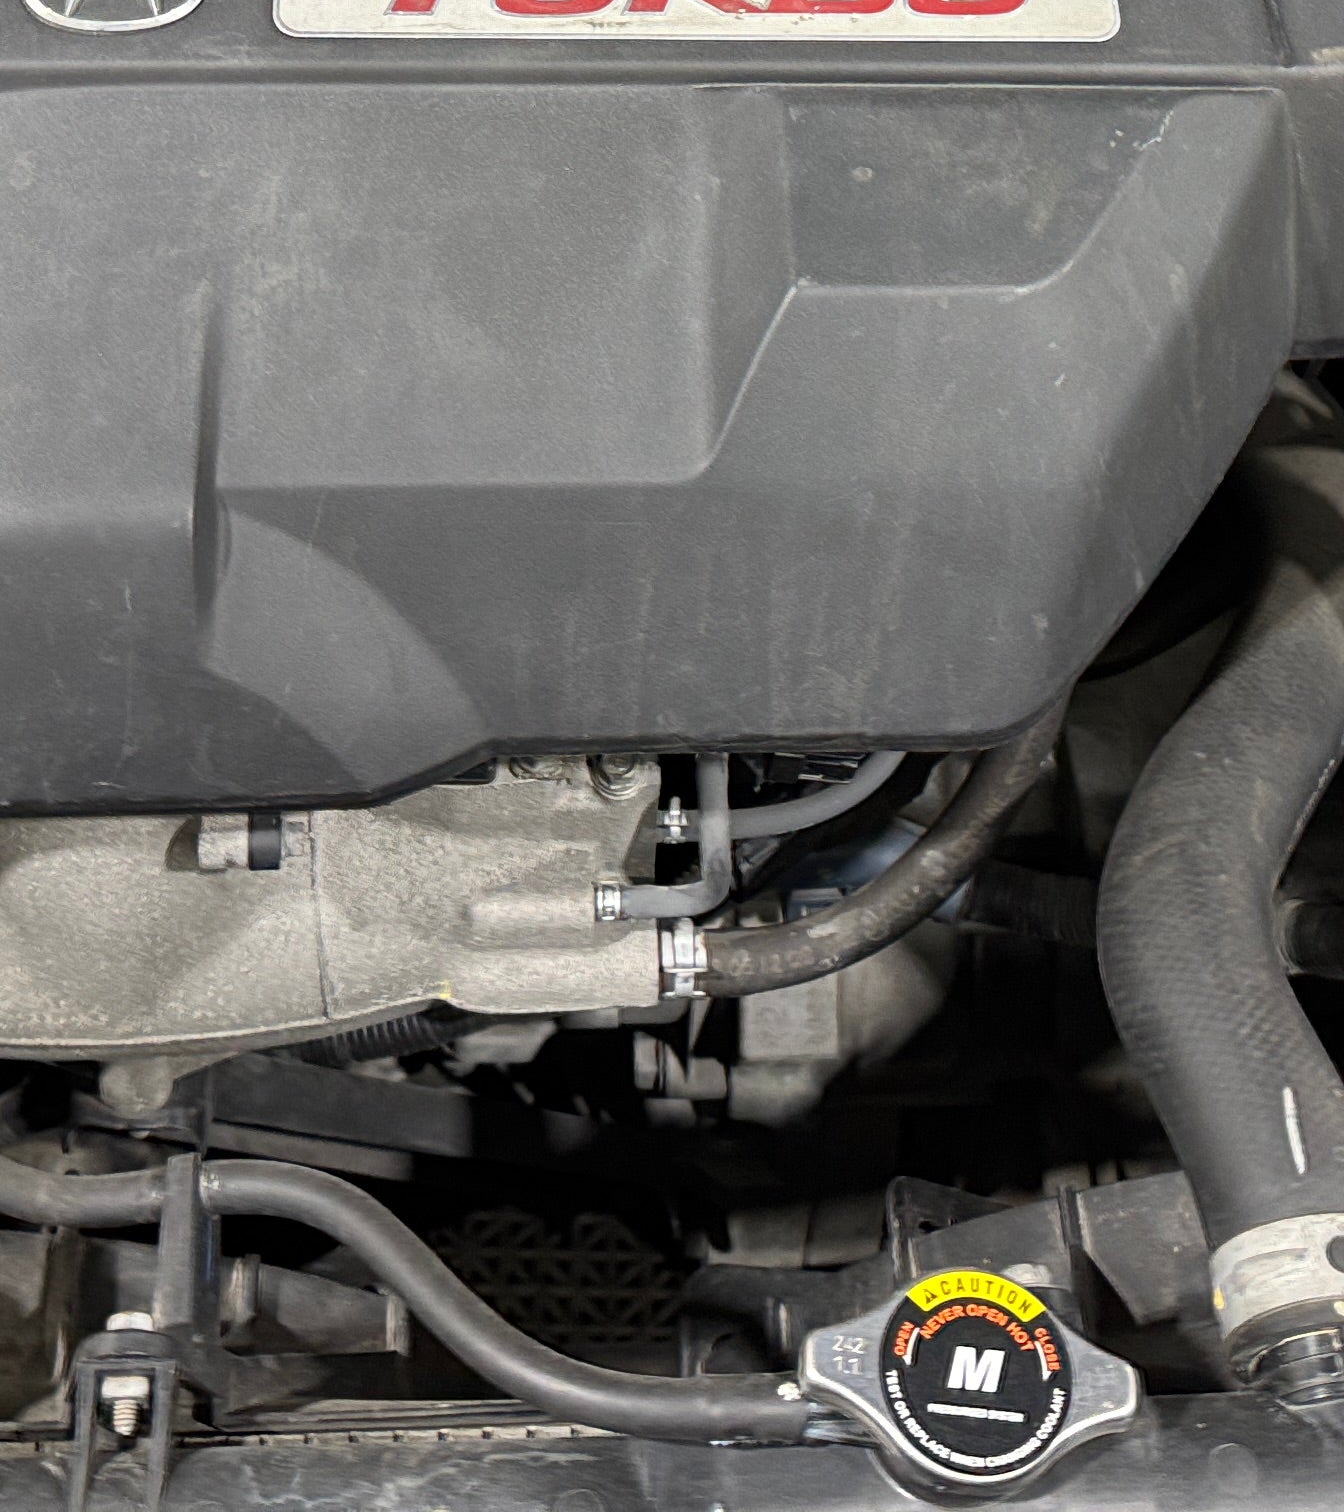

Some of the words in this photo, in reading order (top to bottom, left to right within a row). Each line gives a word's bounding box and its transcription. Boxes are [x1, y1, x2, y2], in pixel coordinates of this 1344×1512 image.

[939, 1278, 1033, 1314] CAUTION
[893, 1321, 915, 1359] OPEN
[919, 1305, 966, 1340] NEVER
[965, 1303, 1009, 1327] OPEN
[1005, 1321, 1036, 1352] HOT
[885, 1369, 903, 1399] TEST
[946, 1345, 1007, 1393] M
[893, 1400, 911, 1420] OR
[1035, 1386, 1067, 1440] COOLANT
[903, 1417, 952, 1459] REPLACE
